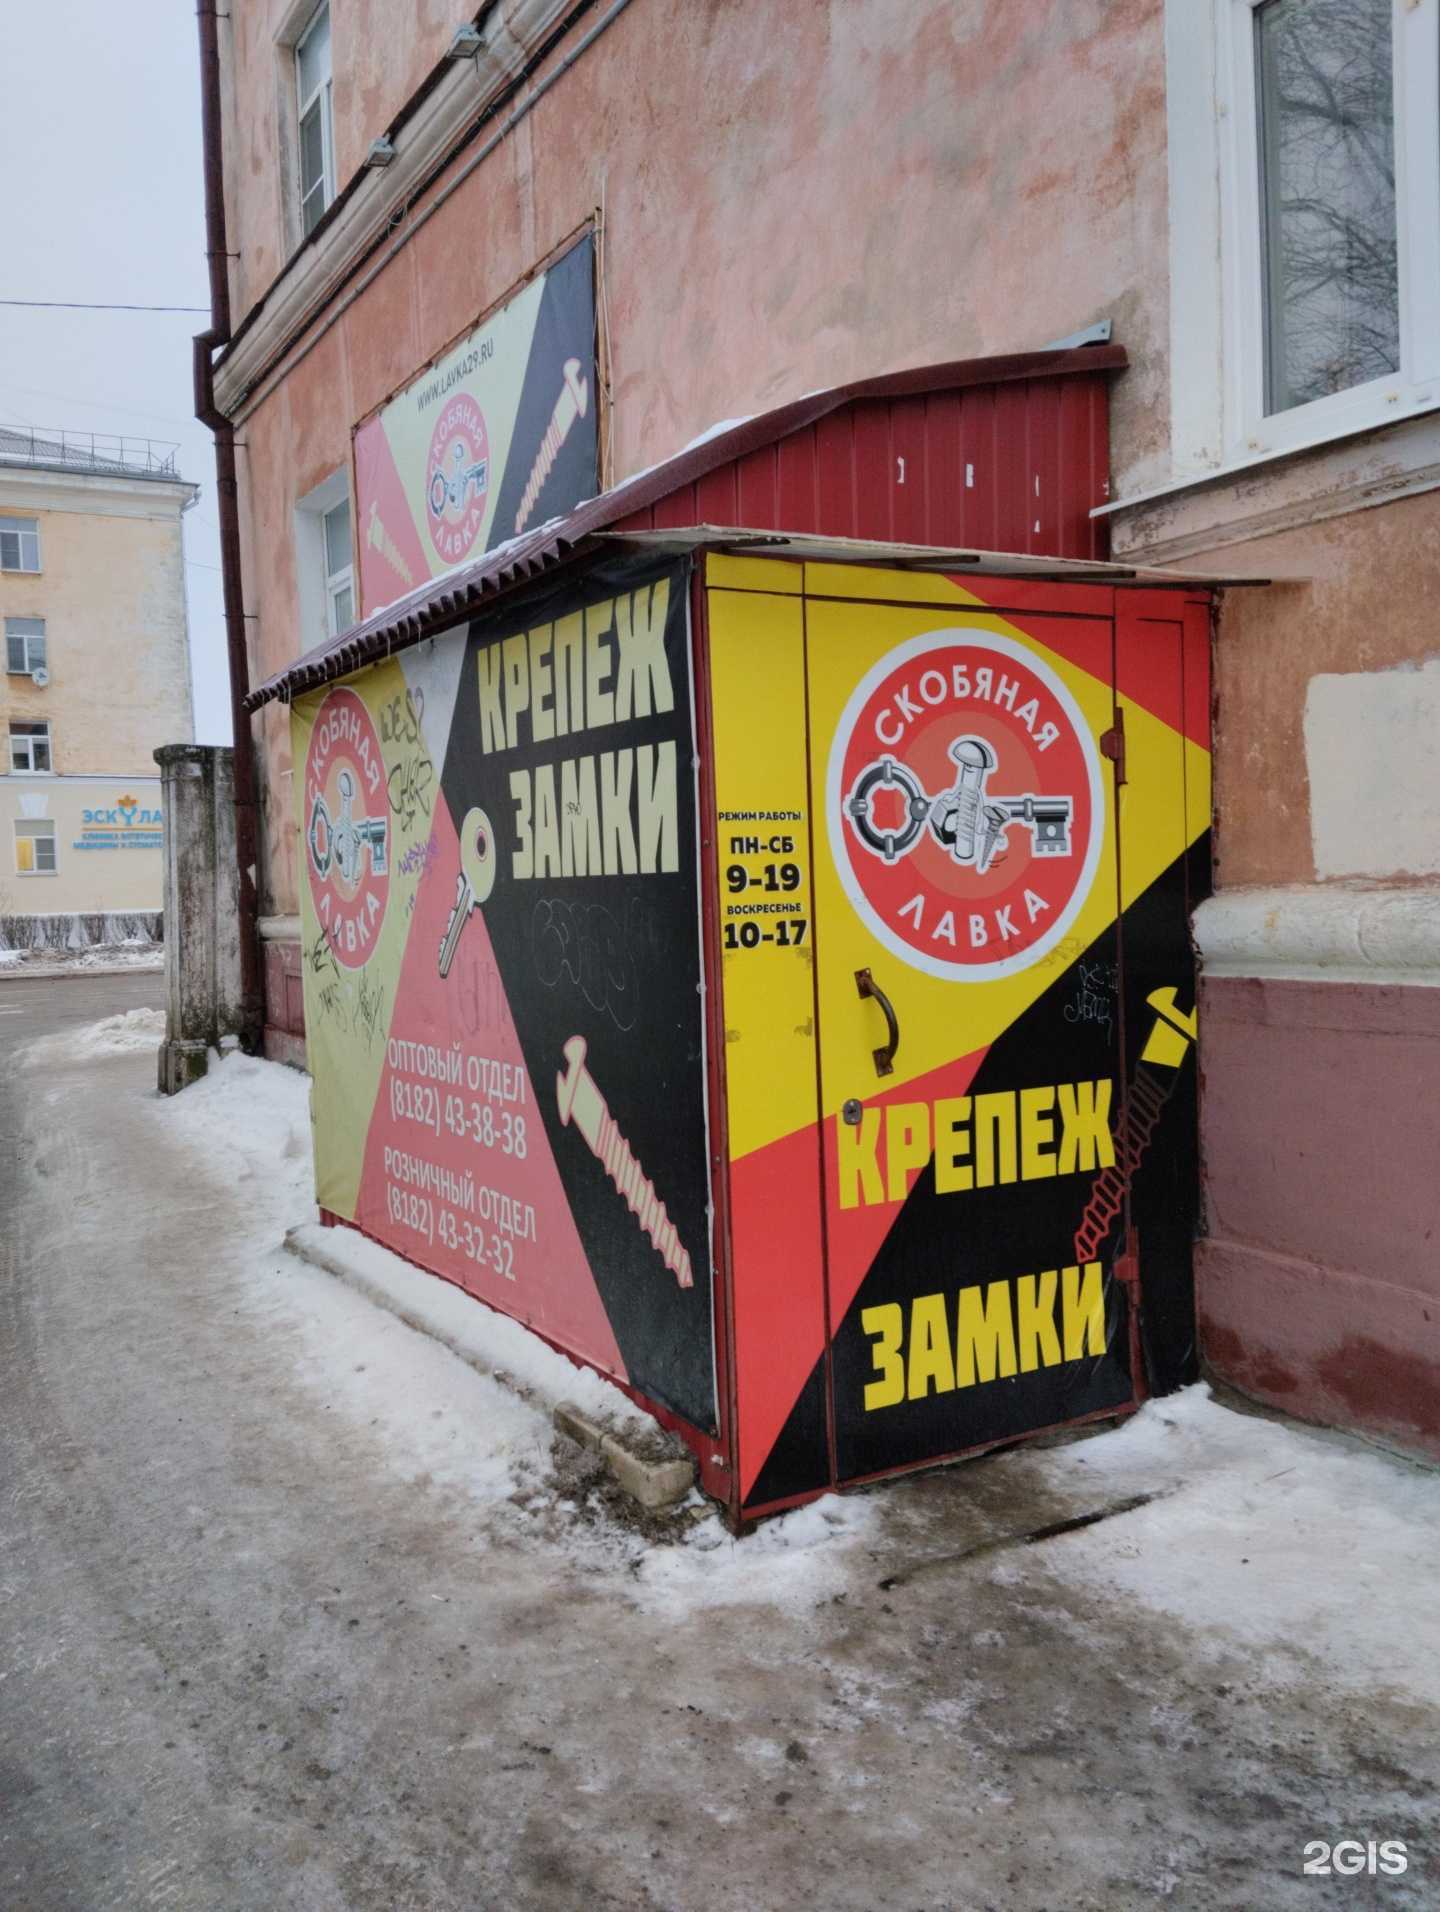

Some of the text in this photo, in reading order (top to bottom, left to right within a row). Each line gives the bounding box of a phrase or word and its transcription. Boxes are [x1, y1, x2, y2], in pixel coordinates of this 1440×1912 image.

[416, 337, 494, 412] WWW.LAVKA29.RU
[435, 508, 480, 554] ЛАВКА
[477, 577, 674, 755] КРЕПЕЖ
[874, 664, 1061, 753] СКОБЯНАЯ
[309, 706, 380, 799] СКОБЯНАЯ
[509, 740, 680, 880] ЗАМКИ
[718, 811, 801, 821] РЕЖИМ РАБОТЫ
[730, 836, 794, 854] ПН-СБ
[726, 863, 801, 893] 9-19
[727, 903, 802, 915] ВОСКРЕСЕНЬЕ
[724, 919, 807, 949] 10-17
[897, 888, 1052, 948] ЛАВКА
[387, 1037, 526, 1106] ОПТОВЫЙ ОТДЕЛ
[390, 1075, 527, 1159] (8182) 43-38-38
[836, 1079, 1116, 1210] КРЕПЕЖ
[384, 1146, 537, 1243] РОЗНИЧНЫЙ ОТДЕЛ
[386, 1181, 517, 1281] (8182) 43-32-32
[861, 1261, 1108, 1411] ЗАМКИ
